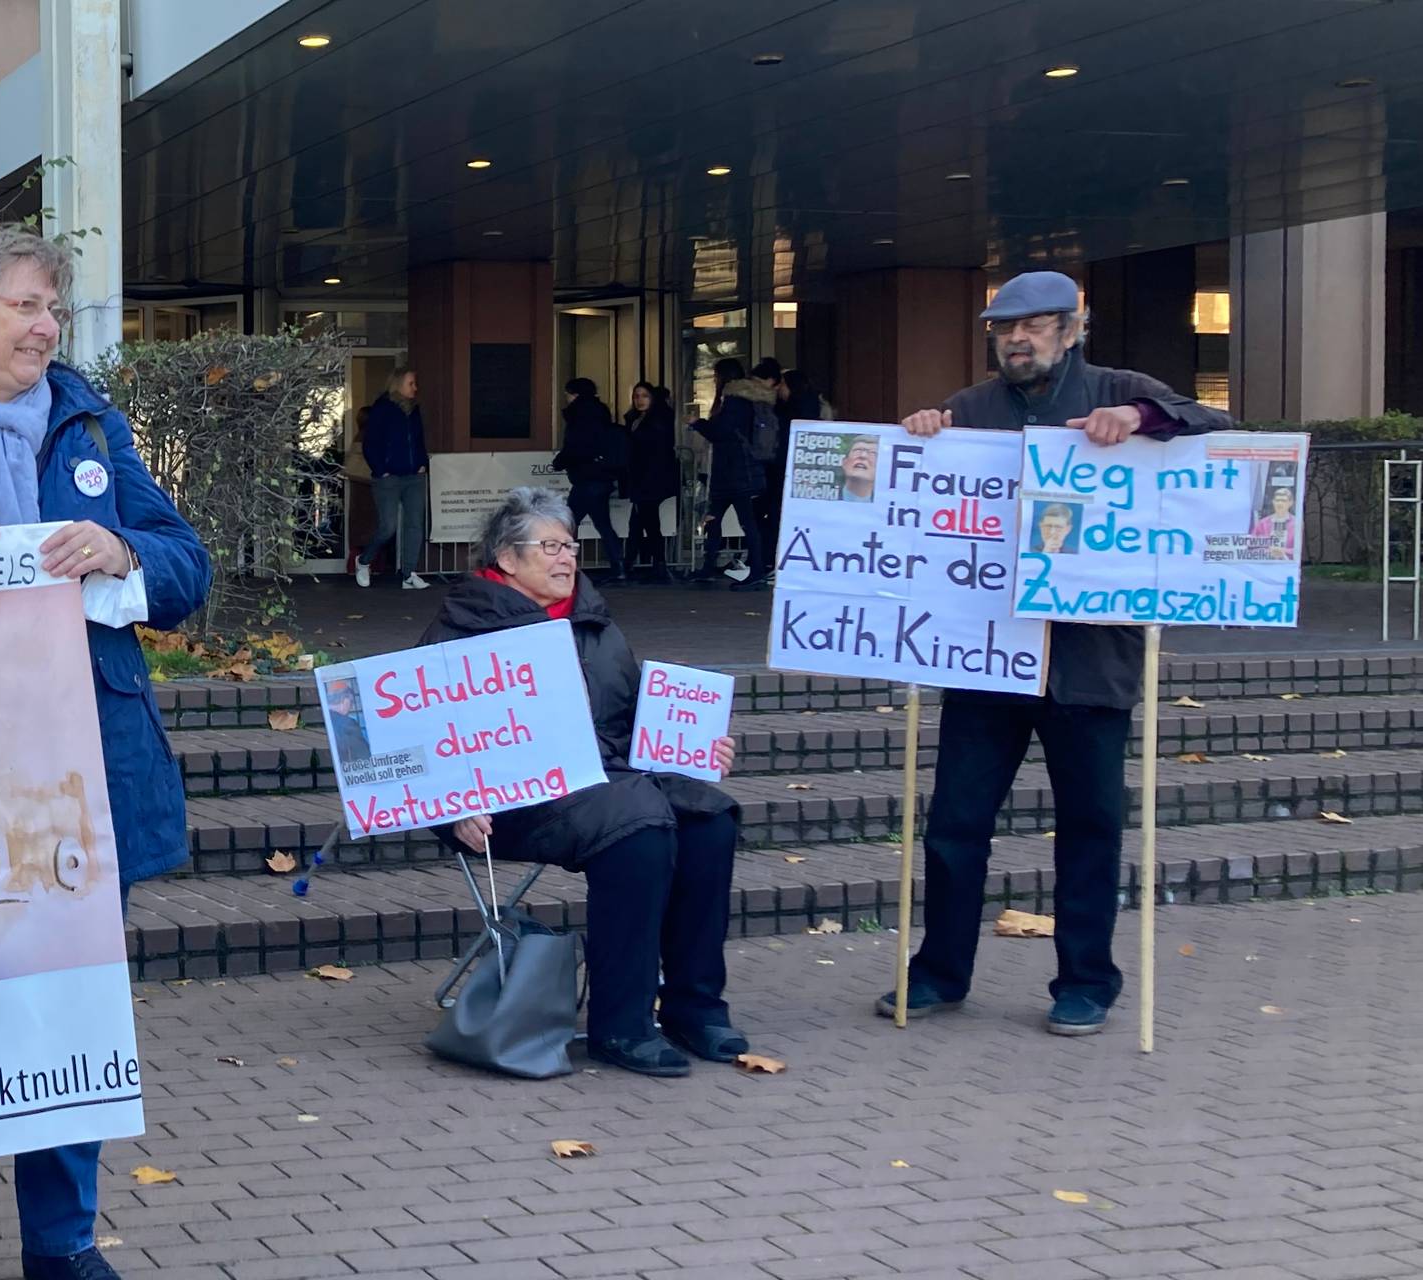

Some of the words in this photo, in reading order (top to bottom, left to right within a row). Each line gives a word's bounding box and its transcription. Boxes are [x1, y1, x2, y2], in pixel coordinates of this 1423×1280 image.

[794, 449, 846, 466] Berater
[796, 431, 842, 449] Eigene
[77, 466, 104, 483] MARIA
[86, 475, 102, 488] 2.0
[791, 484, 840, 500] Woelki
[793, 468, 835, 484] gegen
[1028, 444, 1134, 510] Weg
[1157, 459, 1239, 490] mit
[887, 501, 920, 528] in
[932, 498, 1004, 537] alle
[1083, 511, 1193, 555] dem
[778, 526, 928, 580] Ämter
[946, 542, 1007, 591] de
[1016, 552, 1298, 623] Zwangszölibat
[781, 600, 884, 658] Kath.
[894, 605, 1038, 681] Kirche
[374, 652, 538, 719] Schuldig
[647, 668, 722, 705] Brüder
[435, 708, 533, 758] durch
[667, 703, 698, 725] im
[637, 726, 721, 771] Nebel
[378, 766, 394, 780] soll
[395, 763, 424, 779] gehen
[347, 766, 569, 835] Vertuschung
